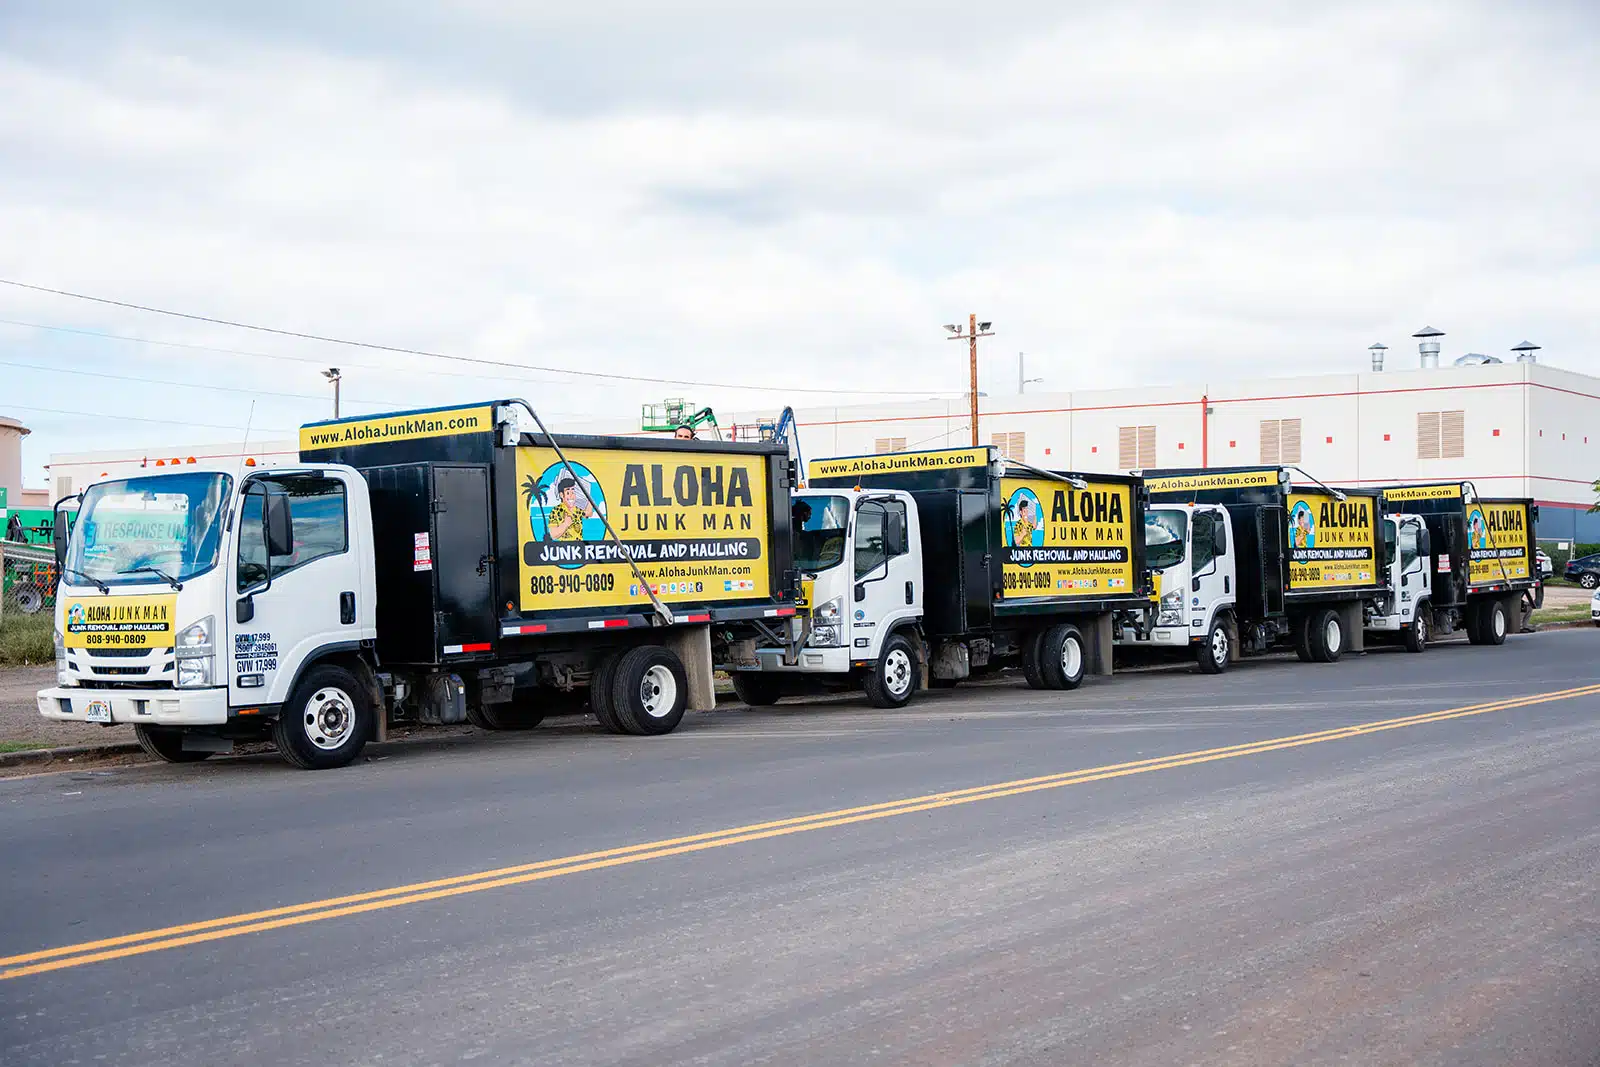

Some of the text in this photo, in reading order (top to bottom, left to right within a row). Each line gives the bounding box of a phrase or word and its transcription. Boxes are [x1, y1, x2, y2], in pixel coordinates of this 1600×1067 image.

[310, 416, 478, 445] www.AlohaJunkMan.com
[820, 453, 975, 474] www.AlohaJunkMan.com
[620, 463, 753, 507] ALOHA
[1051, 490, 1124, 523] ALOHA
[1319, 502, 1369, 528] ALOHA
[621, 513, 751, 531] JUNK MAN
[1489, 510, 1523, 531] ALOHA
[104, 522, 165, 540] RESPONSE
[1051, 526, 1123, 541] JUNK MAN
[1319, 531, 1369, 543] JUNK MAN
[1509, 533, 1524, 544] MAN
[540, 543, 582, 562] JUNK
[659, 542, 688, 560] AND
[690, 541, 748, 558] HAULING
[1009, 548, 1121, 561] JUNK REMOVAL AND HAULING
[530, 572, 614, 595] 808-940-0809
[87, 605, 167, 622] ALOHA JUNK MAN
[87, 623, 118, 632] REMOVAL
[119, 623, 133, 631] AND
[133, 623, 165, 631] HAULING
[86, 634, 146, 644] 808-940-0809
[236, 658, 277, 673] GVW 17,999
